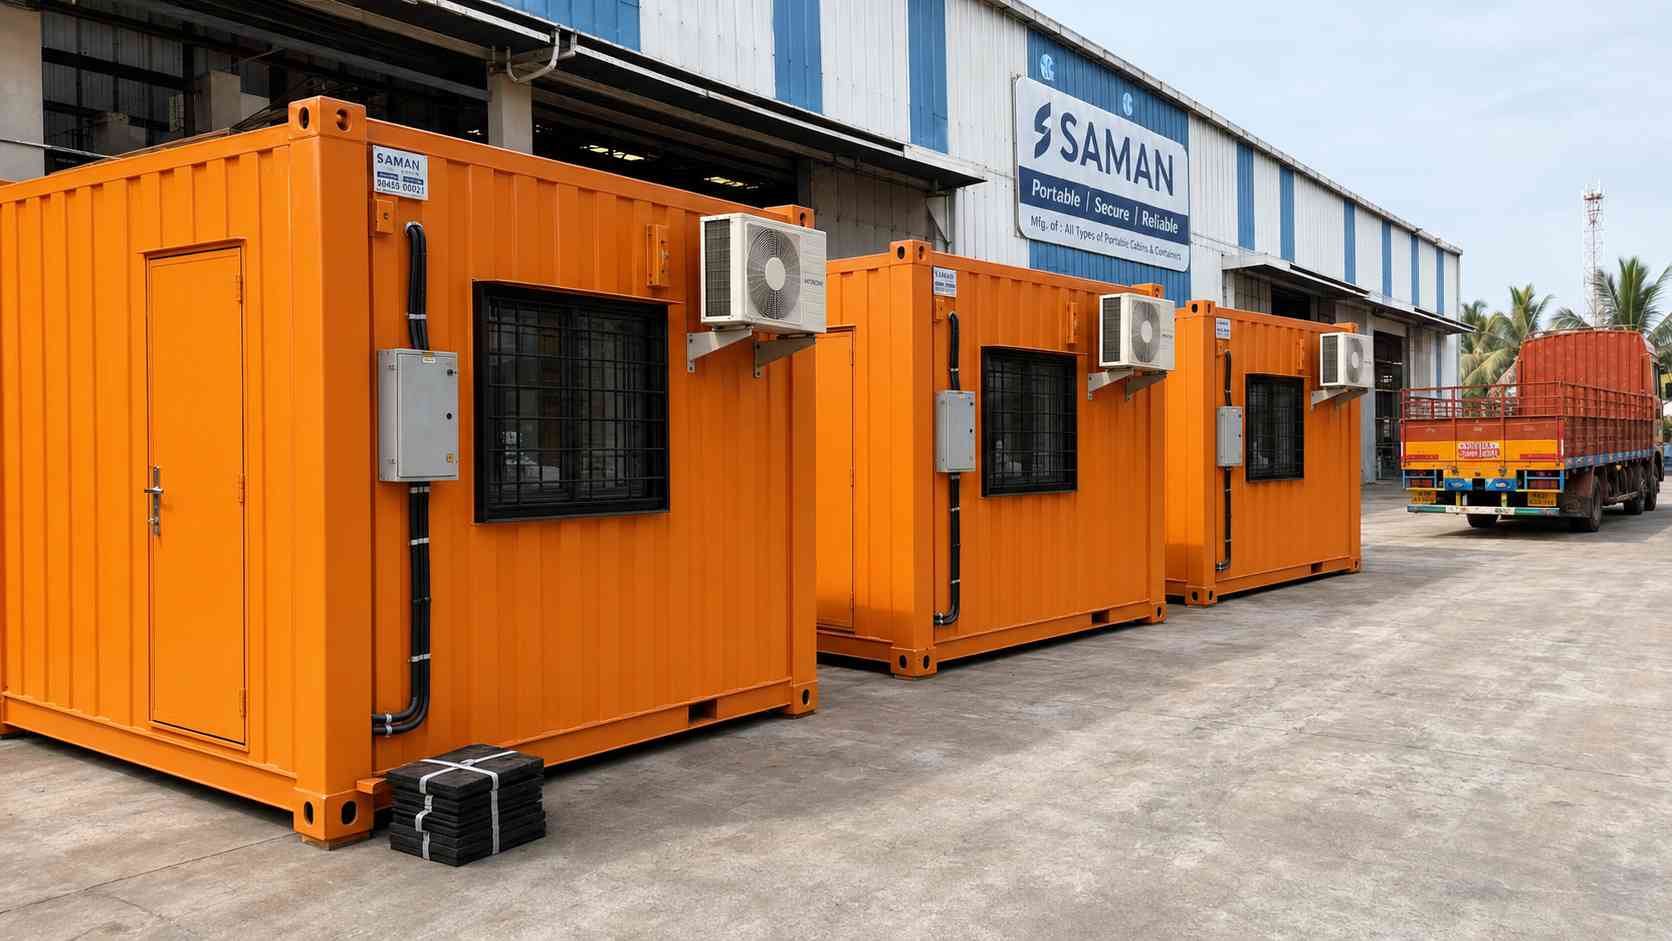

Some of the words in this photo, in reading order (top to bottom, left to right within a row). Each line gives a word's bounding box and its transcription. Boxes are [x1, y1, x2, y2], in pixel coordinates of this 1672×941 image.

[377, 153, 420, 171] SAMAN
[1060, 112, 1174, 197] SAMAN
[1032, 179, 1081, 208] Portable
[1094, 197, 1130, 222] Secure
[1142, 210, 1179, 235] Reliable
[1064, 223, 1075, 237] All
[1076, 226, 1096, 241] Types
[1096, 231, 1104, 241] of
